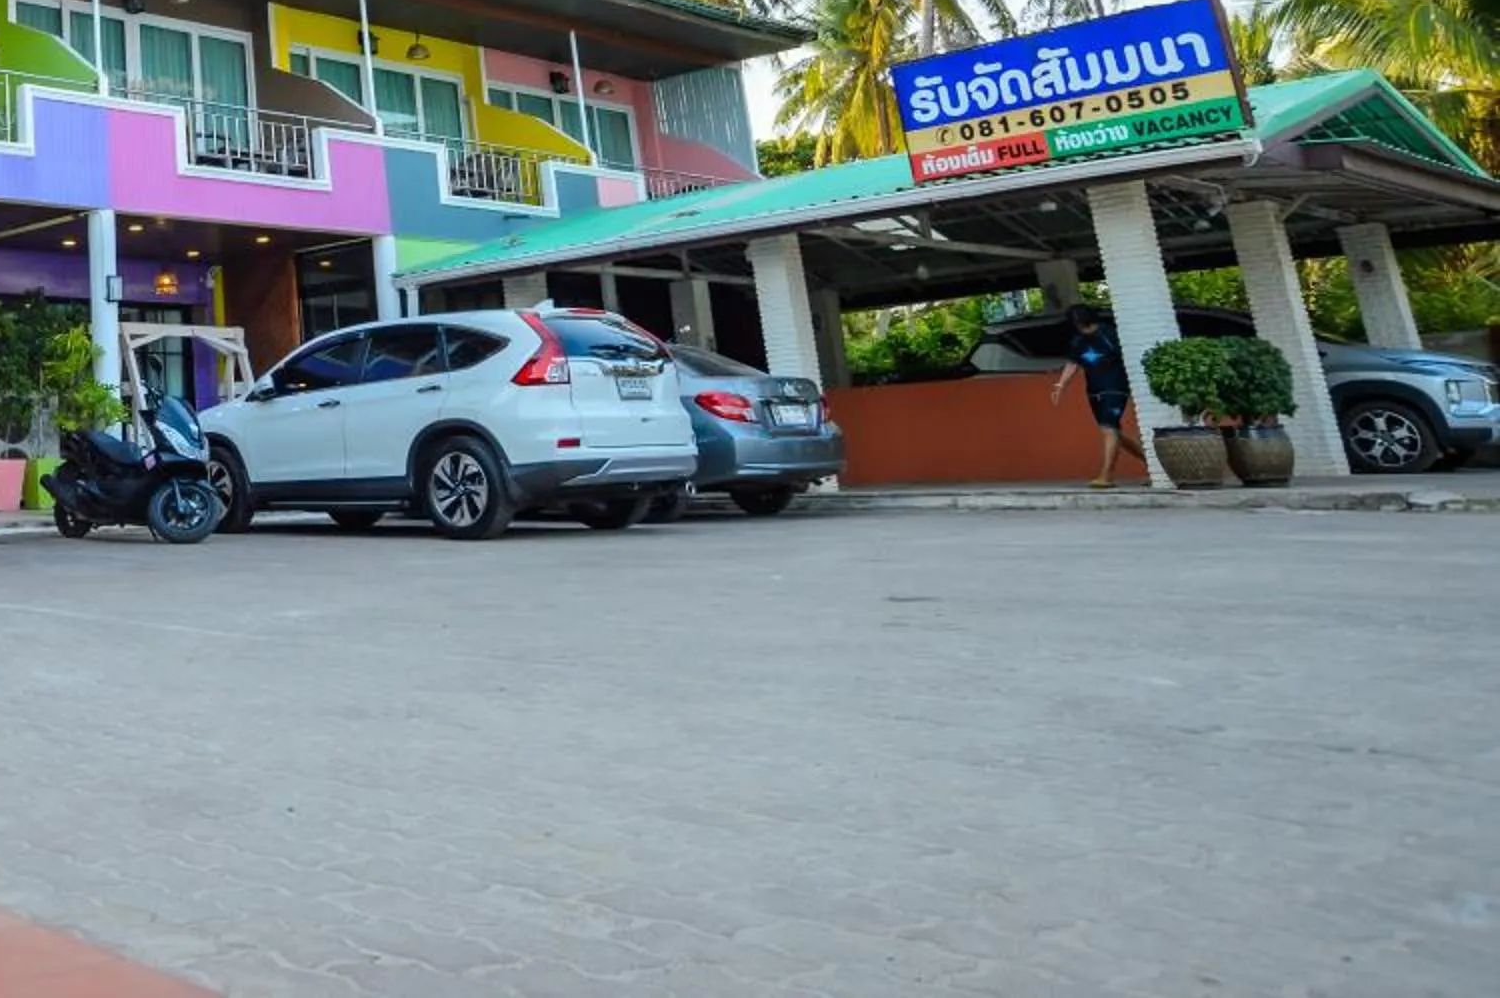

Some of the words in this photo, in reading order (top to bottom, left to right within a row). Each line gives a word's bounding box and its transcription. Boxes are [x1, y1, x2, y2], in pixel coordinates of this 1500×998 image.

[909, 32, 1211, 123] รับจัดสัมมนา
[959, 82, 1190, 141] 081-607-0505
[1054, 122, 1130, 152] ห้องว่าง
[1131, 105, 1234, 137] VACANCY
[921, 144, 995, 175] ห้องเต็ม
[997, 140, 1045, 161] FULL
